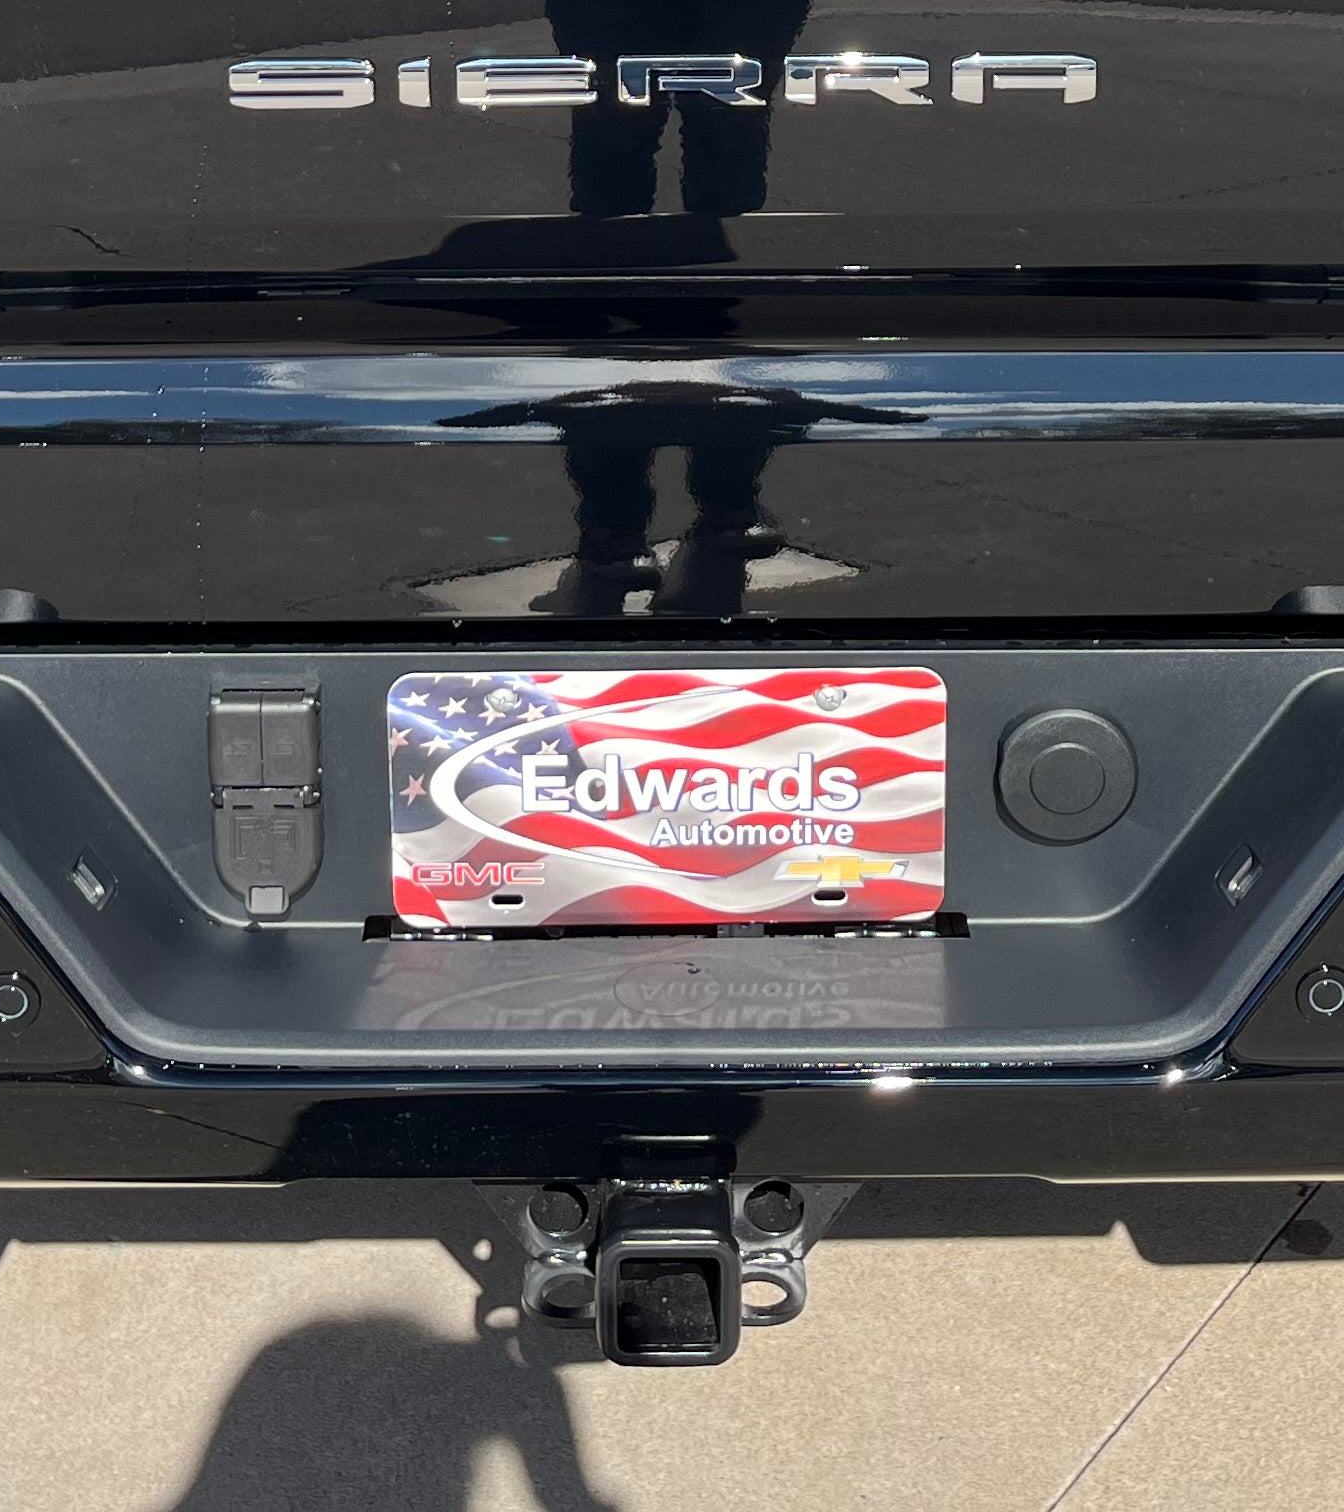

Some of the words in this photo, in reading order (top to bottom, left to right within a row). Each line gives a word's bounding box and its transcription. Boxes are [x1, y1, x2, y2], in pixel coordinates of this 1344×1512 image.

[228, 52, 1099, 110] SIERRA
[521, 752, 862, 813] Edwards
[650, 818, 855, 847] Automotive
[410, 862, 545, 886] GMC
